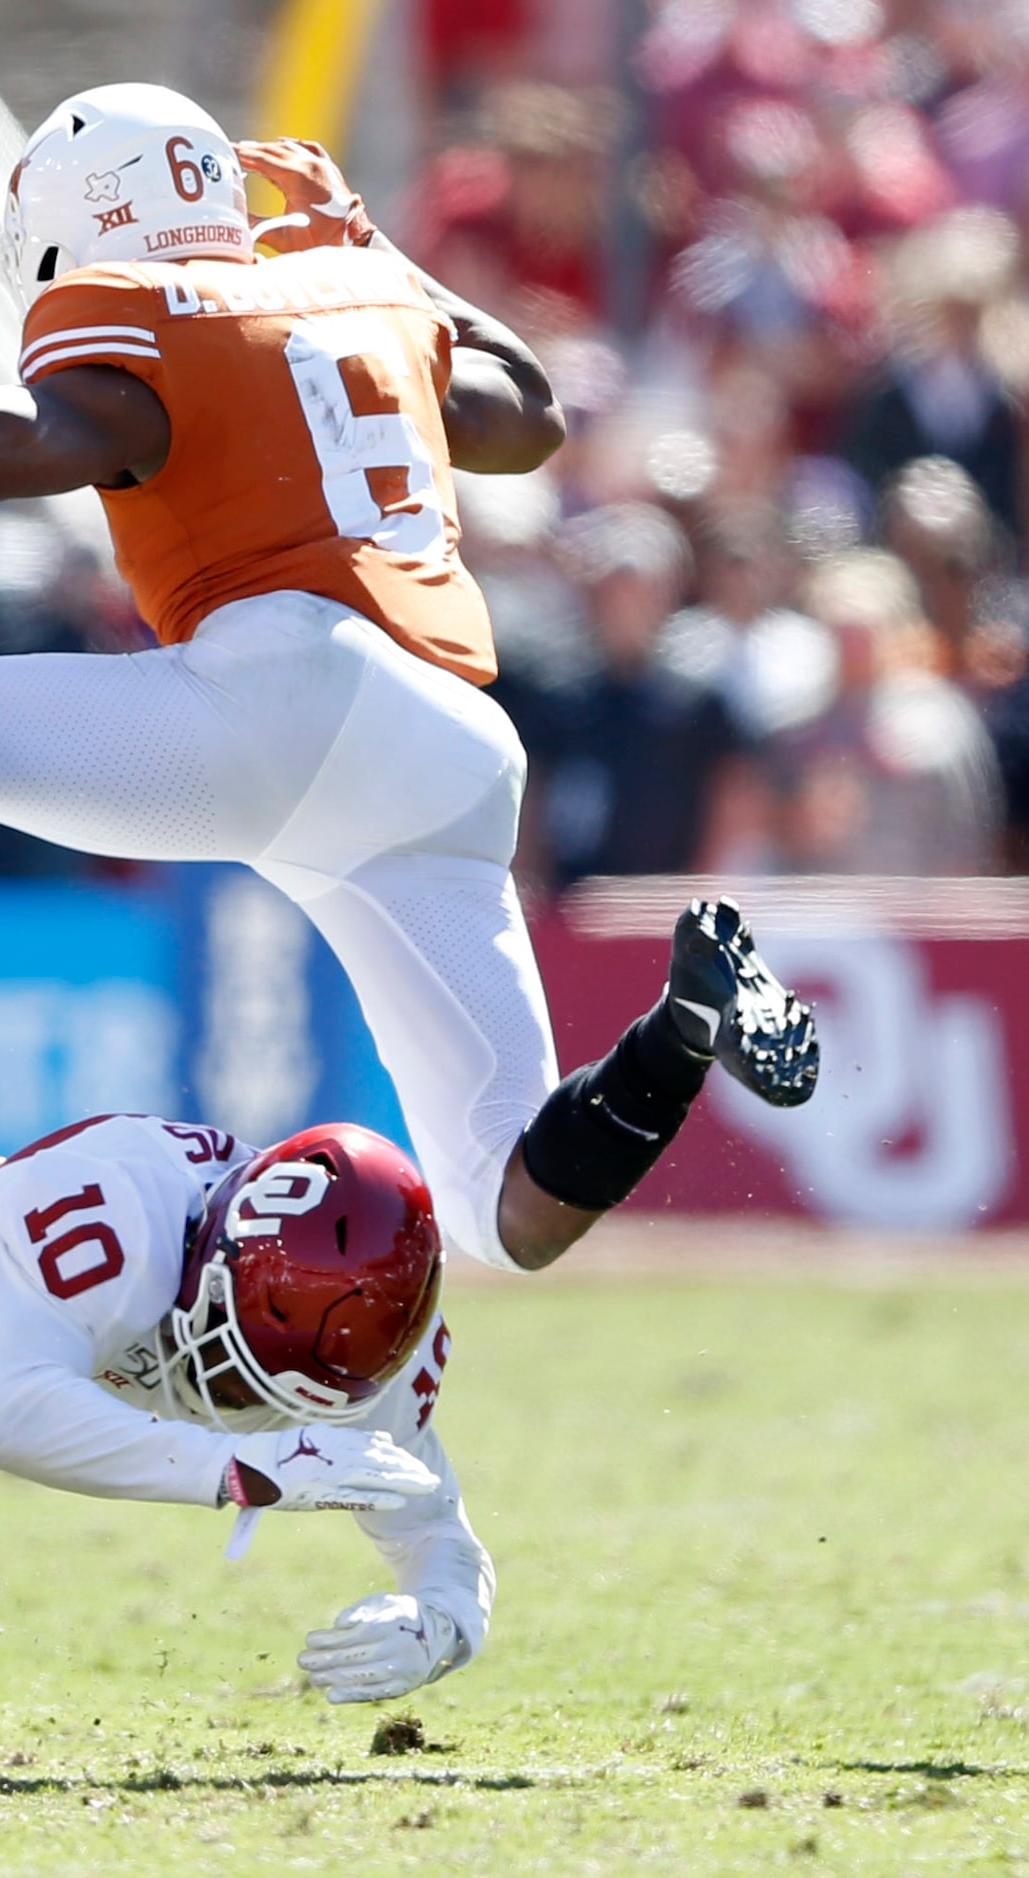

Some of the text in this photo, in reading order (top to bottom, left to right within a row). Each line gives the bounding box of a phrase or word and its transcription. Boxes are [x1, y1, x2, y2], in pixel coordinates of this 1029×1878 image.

[165, 136, 204, 203] 6
[92, 200, 139, 237] XII
[143, 225, 243, 252] LONGHORNS
[283, 314, 446, 563] 6
[23, 1183, 125, 1300] 10
